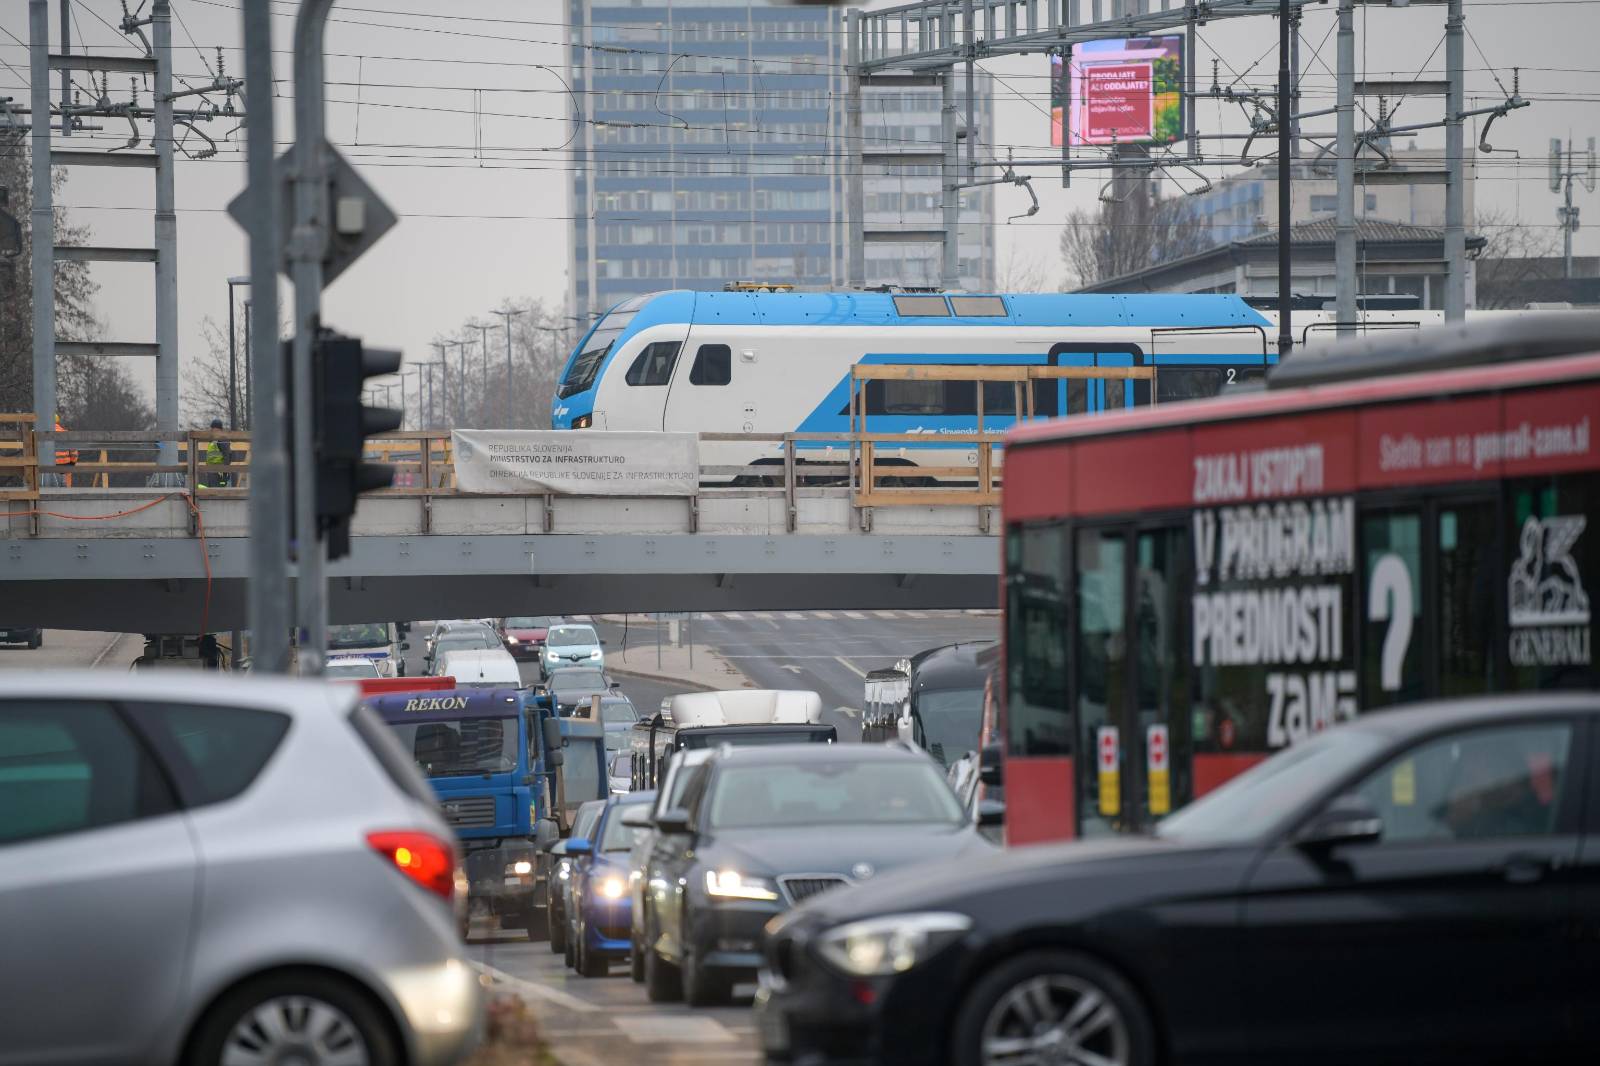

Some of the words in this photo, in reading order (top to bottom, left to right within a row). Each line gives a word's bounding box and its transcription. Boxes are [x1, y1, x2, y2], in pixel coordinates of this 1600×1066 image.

[1226, 368, 1236, 385] 2
[488, 444, 531, 453] REPUBLIKA
[533, 444, 573, 453] SLOVENIJA
[490, 455, 541, 463] MINISTRSTVO
[542, 455, 552, 463] ZA
[555, 455, 626, 464] INFRASTRUKTURO
[572, 471, 612, 480] SLOVENIJE
[613, 471, 624, 480] ZA
[625, 471, 694, 481] INFRASTRUKTURO
[1193, 453, 1248, 503] ZAKAJ
[1193, 510, 1215, 584] V
[1219, 498, 1355, 581] PROGRAM
[1193, 586, 1342, 666] PREDNOSTI
[1508, 626, 1592, 667] GENERALI
[404, 696, 470, 712] REKON
